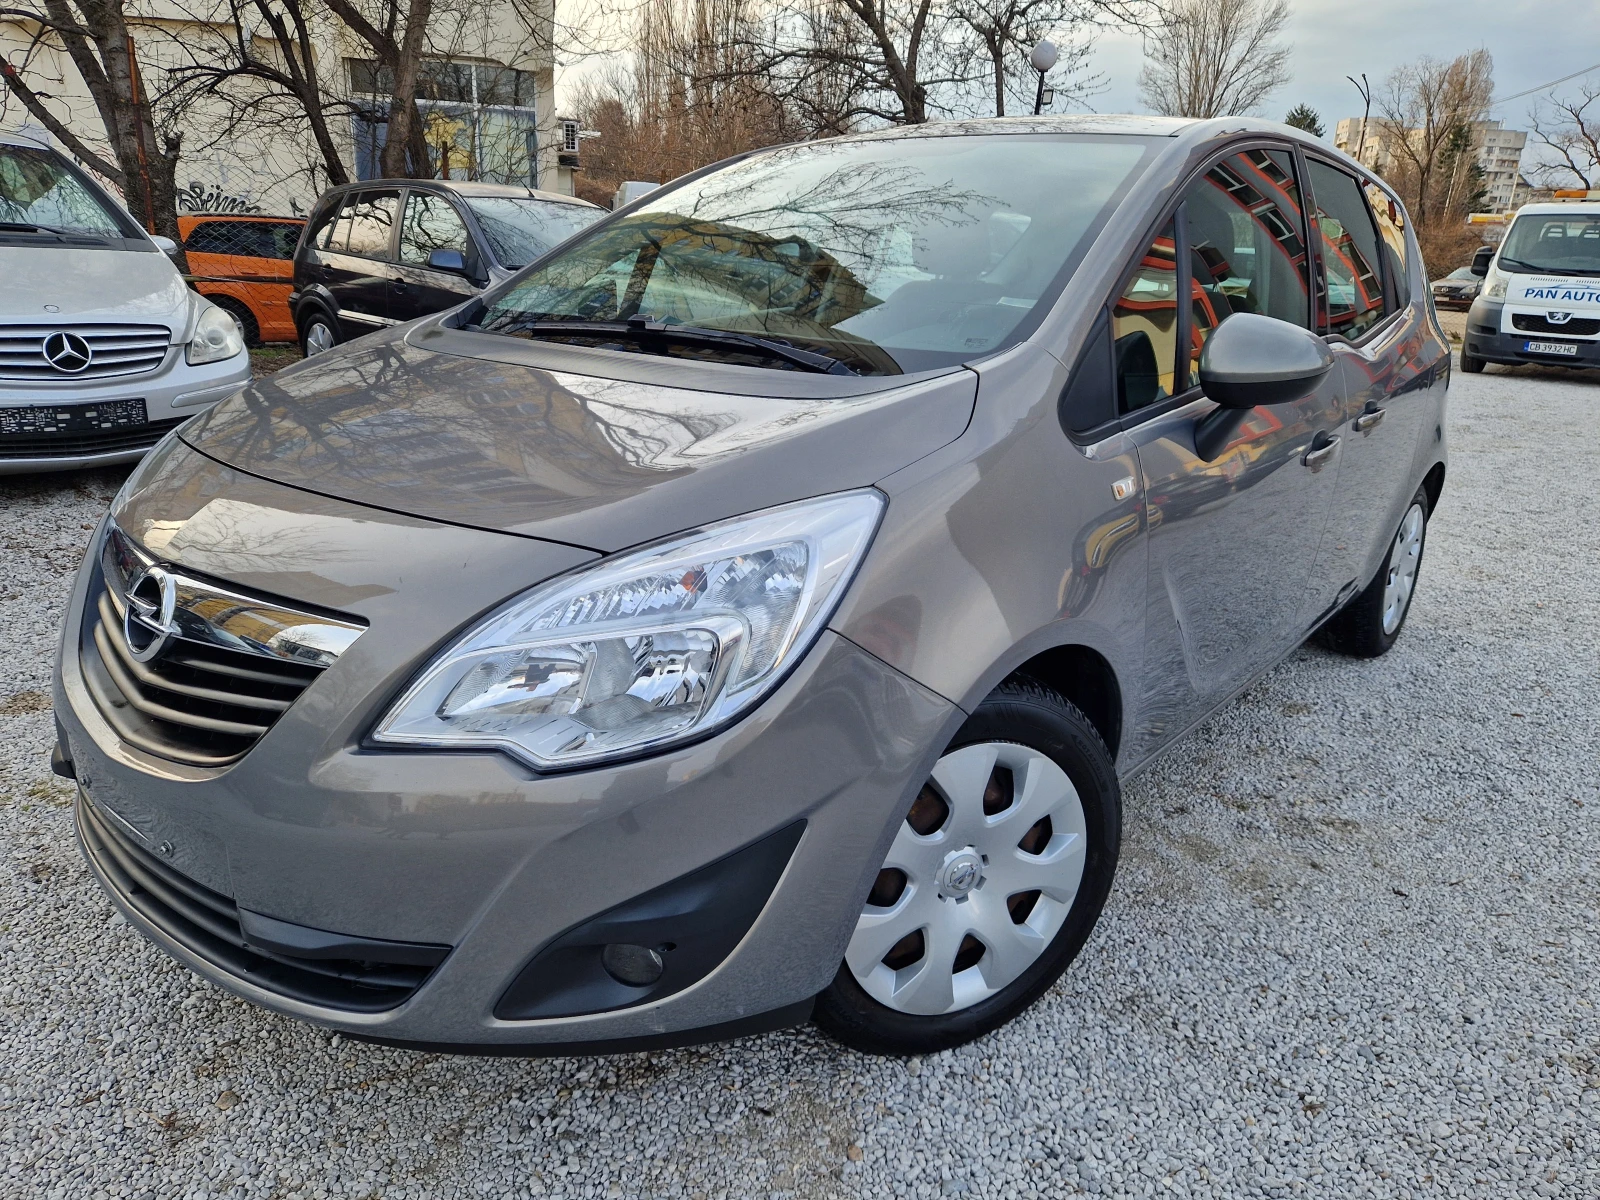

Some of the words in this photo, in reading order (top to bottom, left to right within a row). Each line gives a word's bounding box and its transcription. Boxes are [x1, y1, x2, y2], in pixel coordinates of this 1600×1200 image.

[1524, 288, 1558, 300] PAN
[1529, 343, 1541, 352] CB
[1541, 344, 1563, 353] 3932
[1563, 345, 1576, 354] HC
